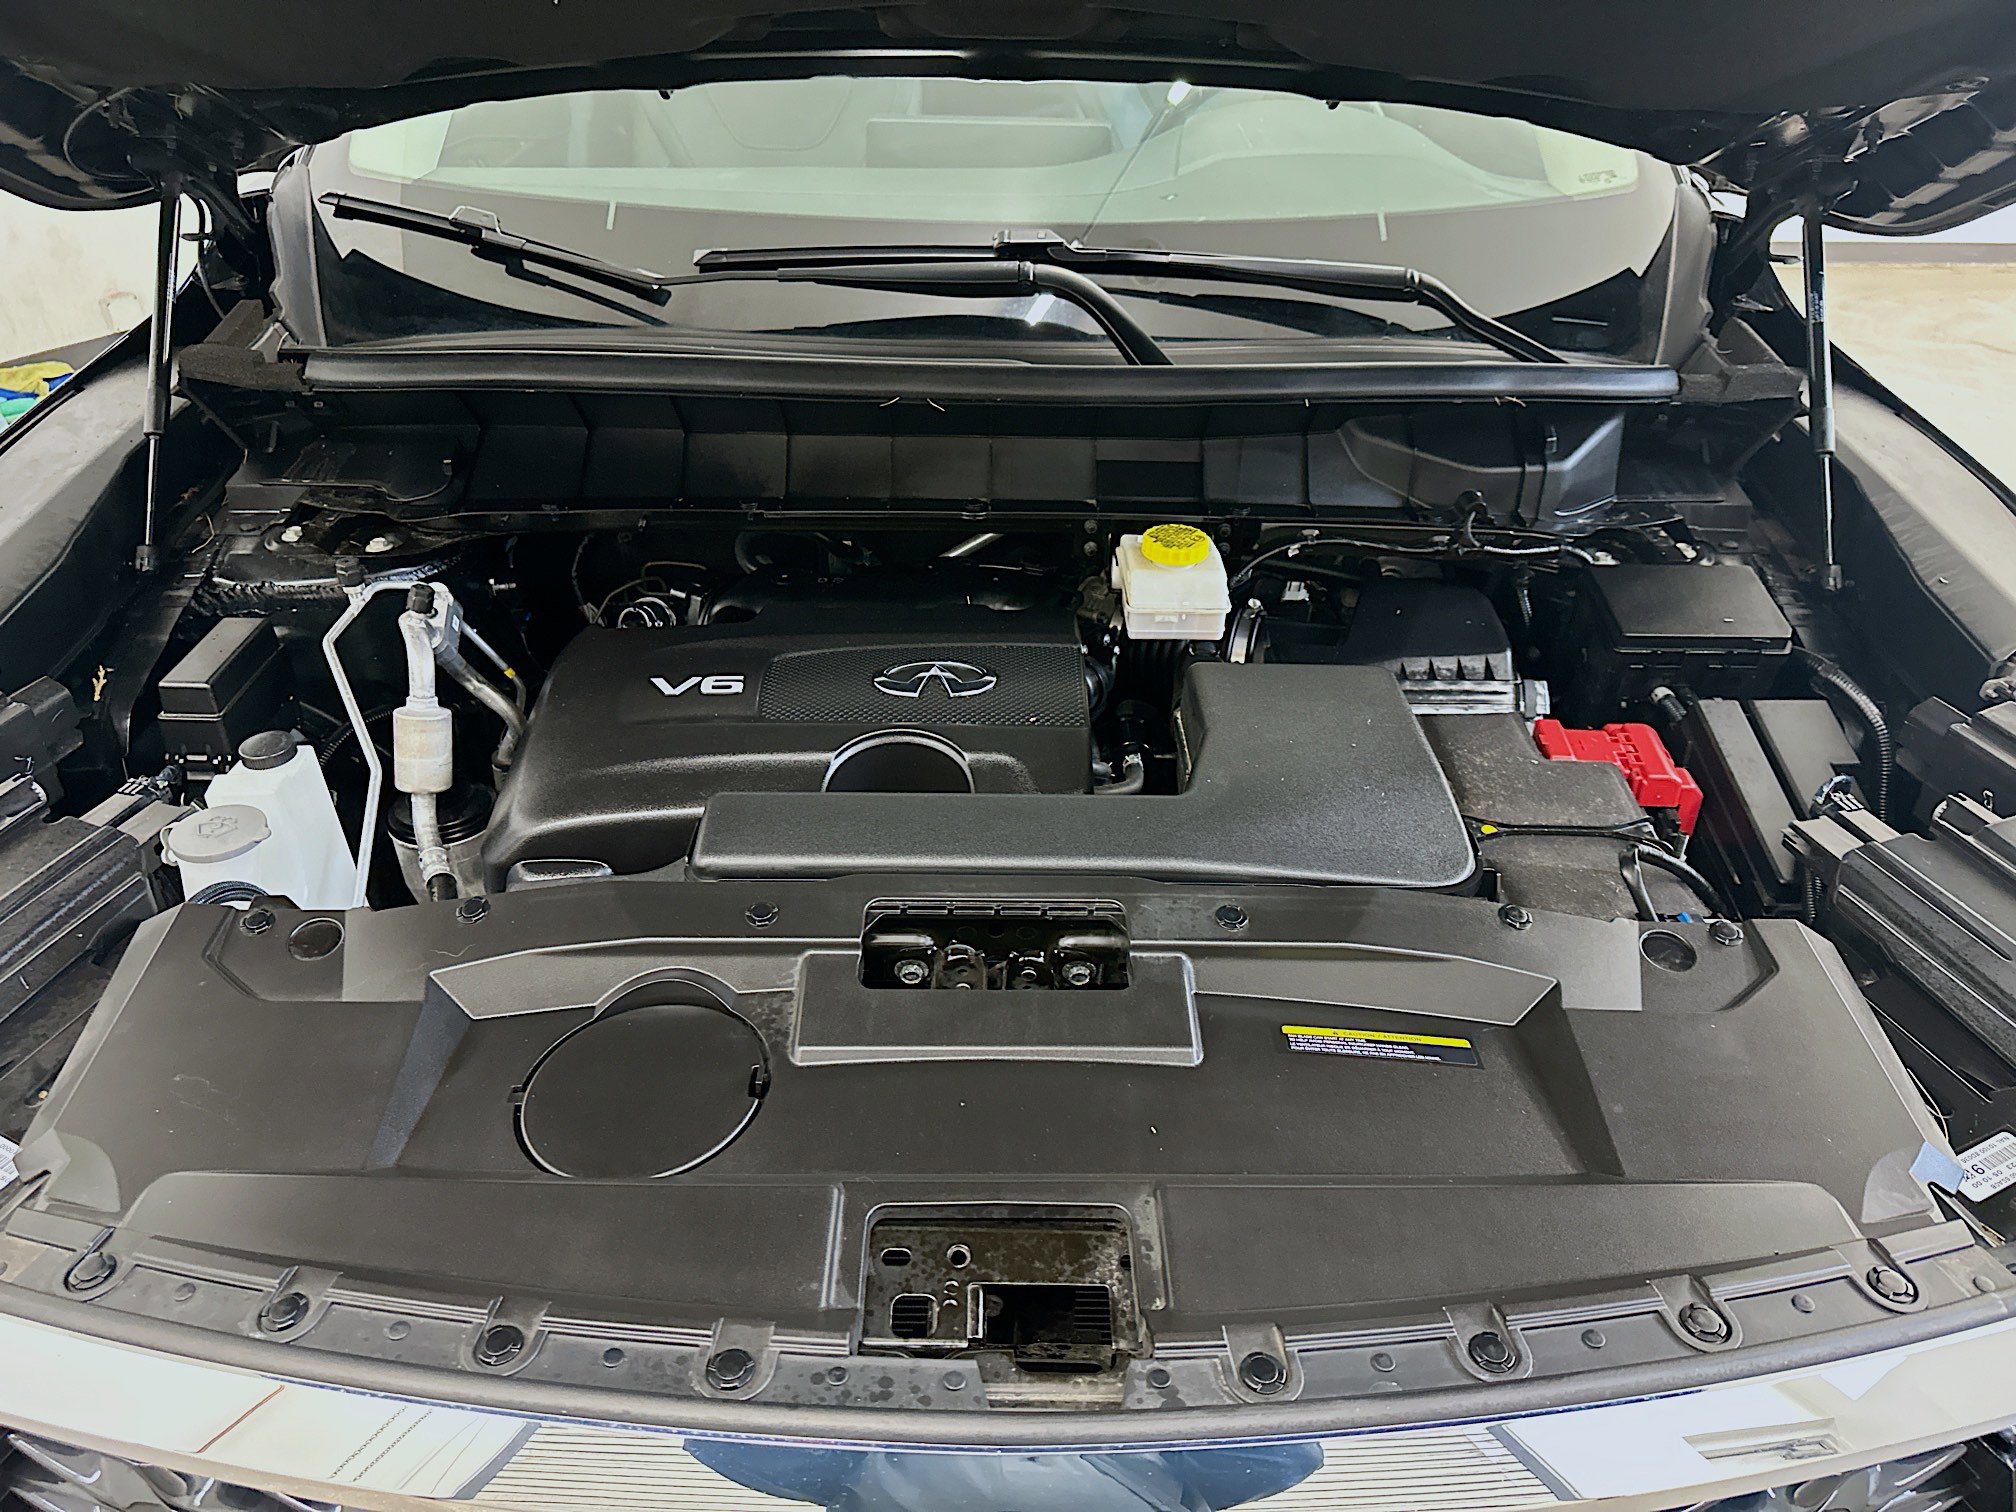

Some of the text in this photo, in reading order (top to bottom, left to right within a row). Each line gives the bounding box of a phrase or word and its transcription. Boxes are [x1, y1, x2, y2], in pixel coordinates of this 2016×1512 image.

[650, 676, 744, 695] V6
[1383, 1034, 1422, 1042] ATTENTION
[1971, 1164, 1985, 1175] 9
